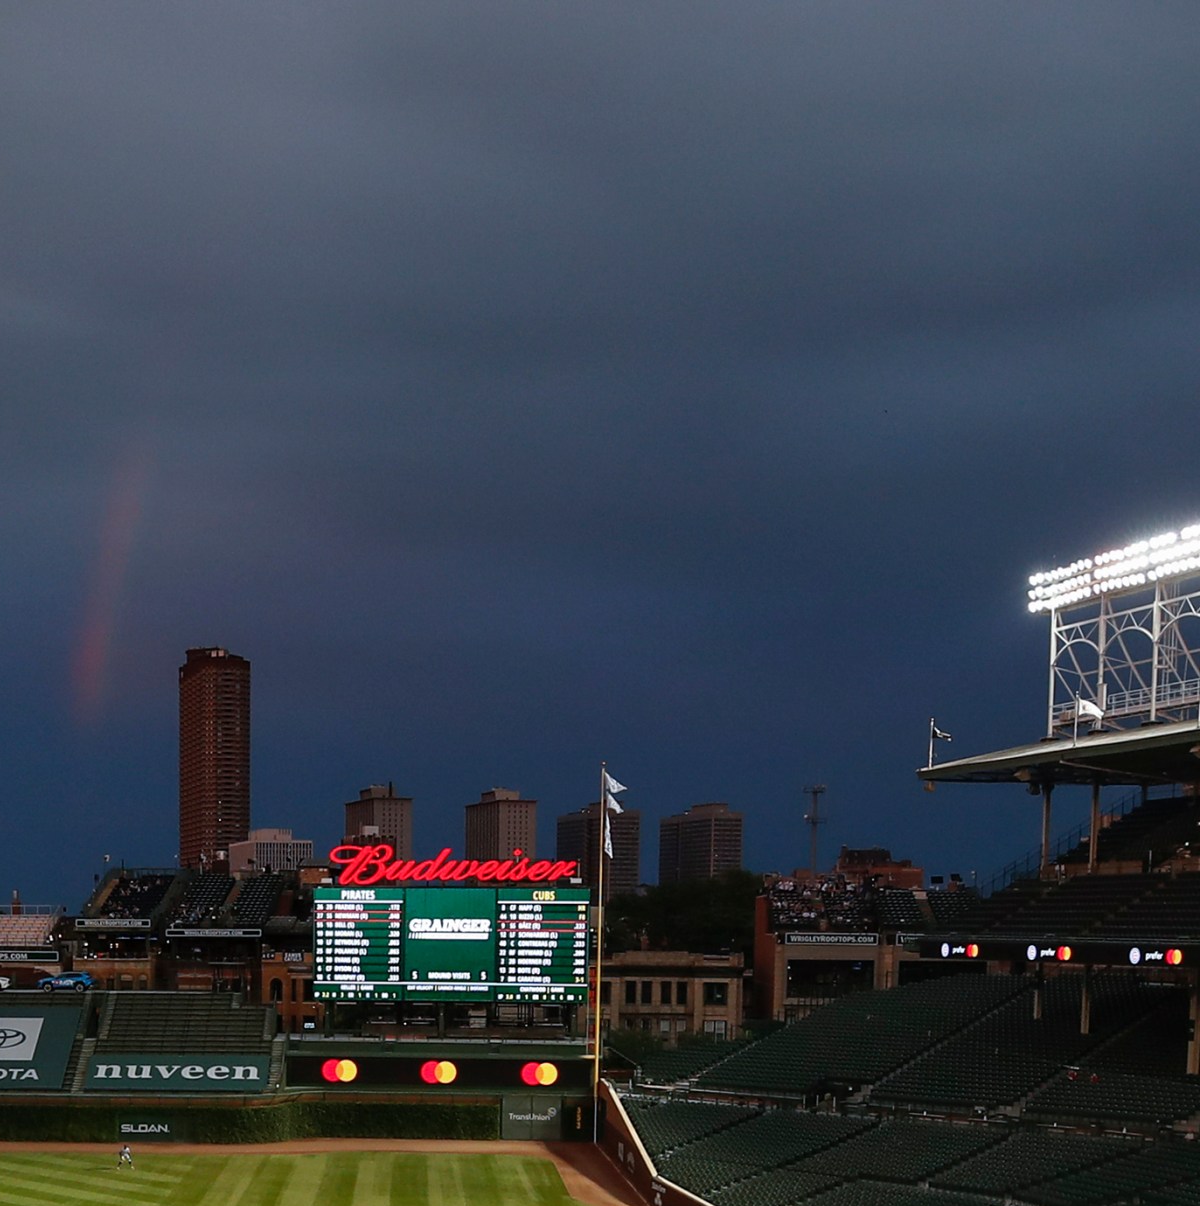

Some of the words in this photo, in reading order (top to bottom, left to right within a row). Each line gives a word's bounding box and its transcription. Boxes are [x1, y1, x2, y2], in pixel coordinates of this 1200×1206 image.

[330, 844, 577, 885] Budweiser
[341, 890, 375, 900] PIRATES
[532, 891, 555, 900] CUBS
[408, 919, 492, 932] GRAINGER
[790, 935, 874, 943] WRIGLEYROOFTOPS.COM
[1040, 948, 1056, 957] prefer
[1145, 951, 1164, 961] prefer
[94, 1063, 260, 1080] nuveen
[508, 1112, 550, 1120] TransUnion
